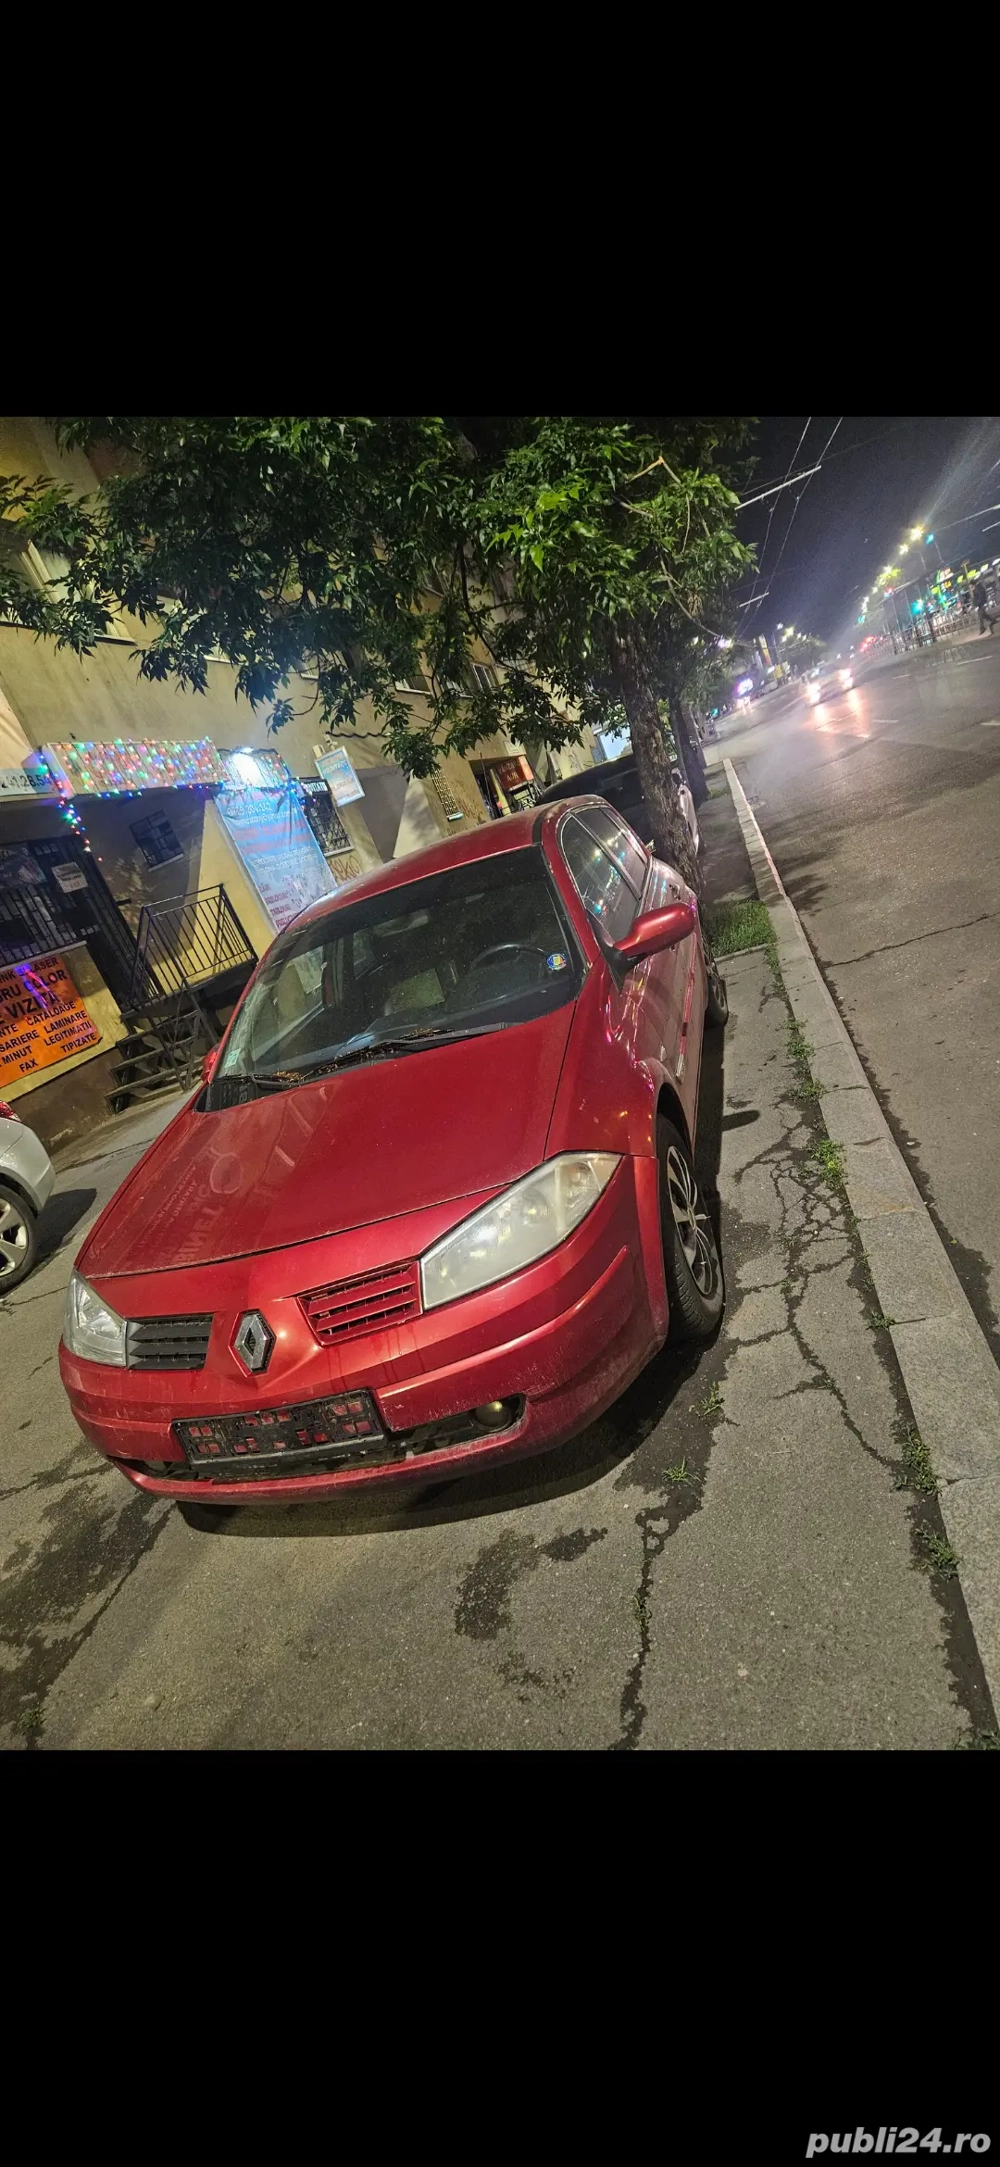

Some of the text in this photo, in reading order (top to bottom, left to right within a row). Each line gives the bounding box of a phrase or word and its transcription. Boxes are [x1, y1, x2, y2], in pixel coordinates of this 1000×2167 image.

[24, 970, 67, 992] COLOR
[6, 990, 61, 1018] VIZITA
[27, 1001, 76, 1026] CATALOAGE
[44, 1010, 87, 1033] LAMINARE
[1, 1021, 92, 1064] MINUT LEGITIMATII
[19, 1033, 97, 1073] FAX TIPIZATE
